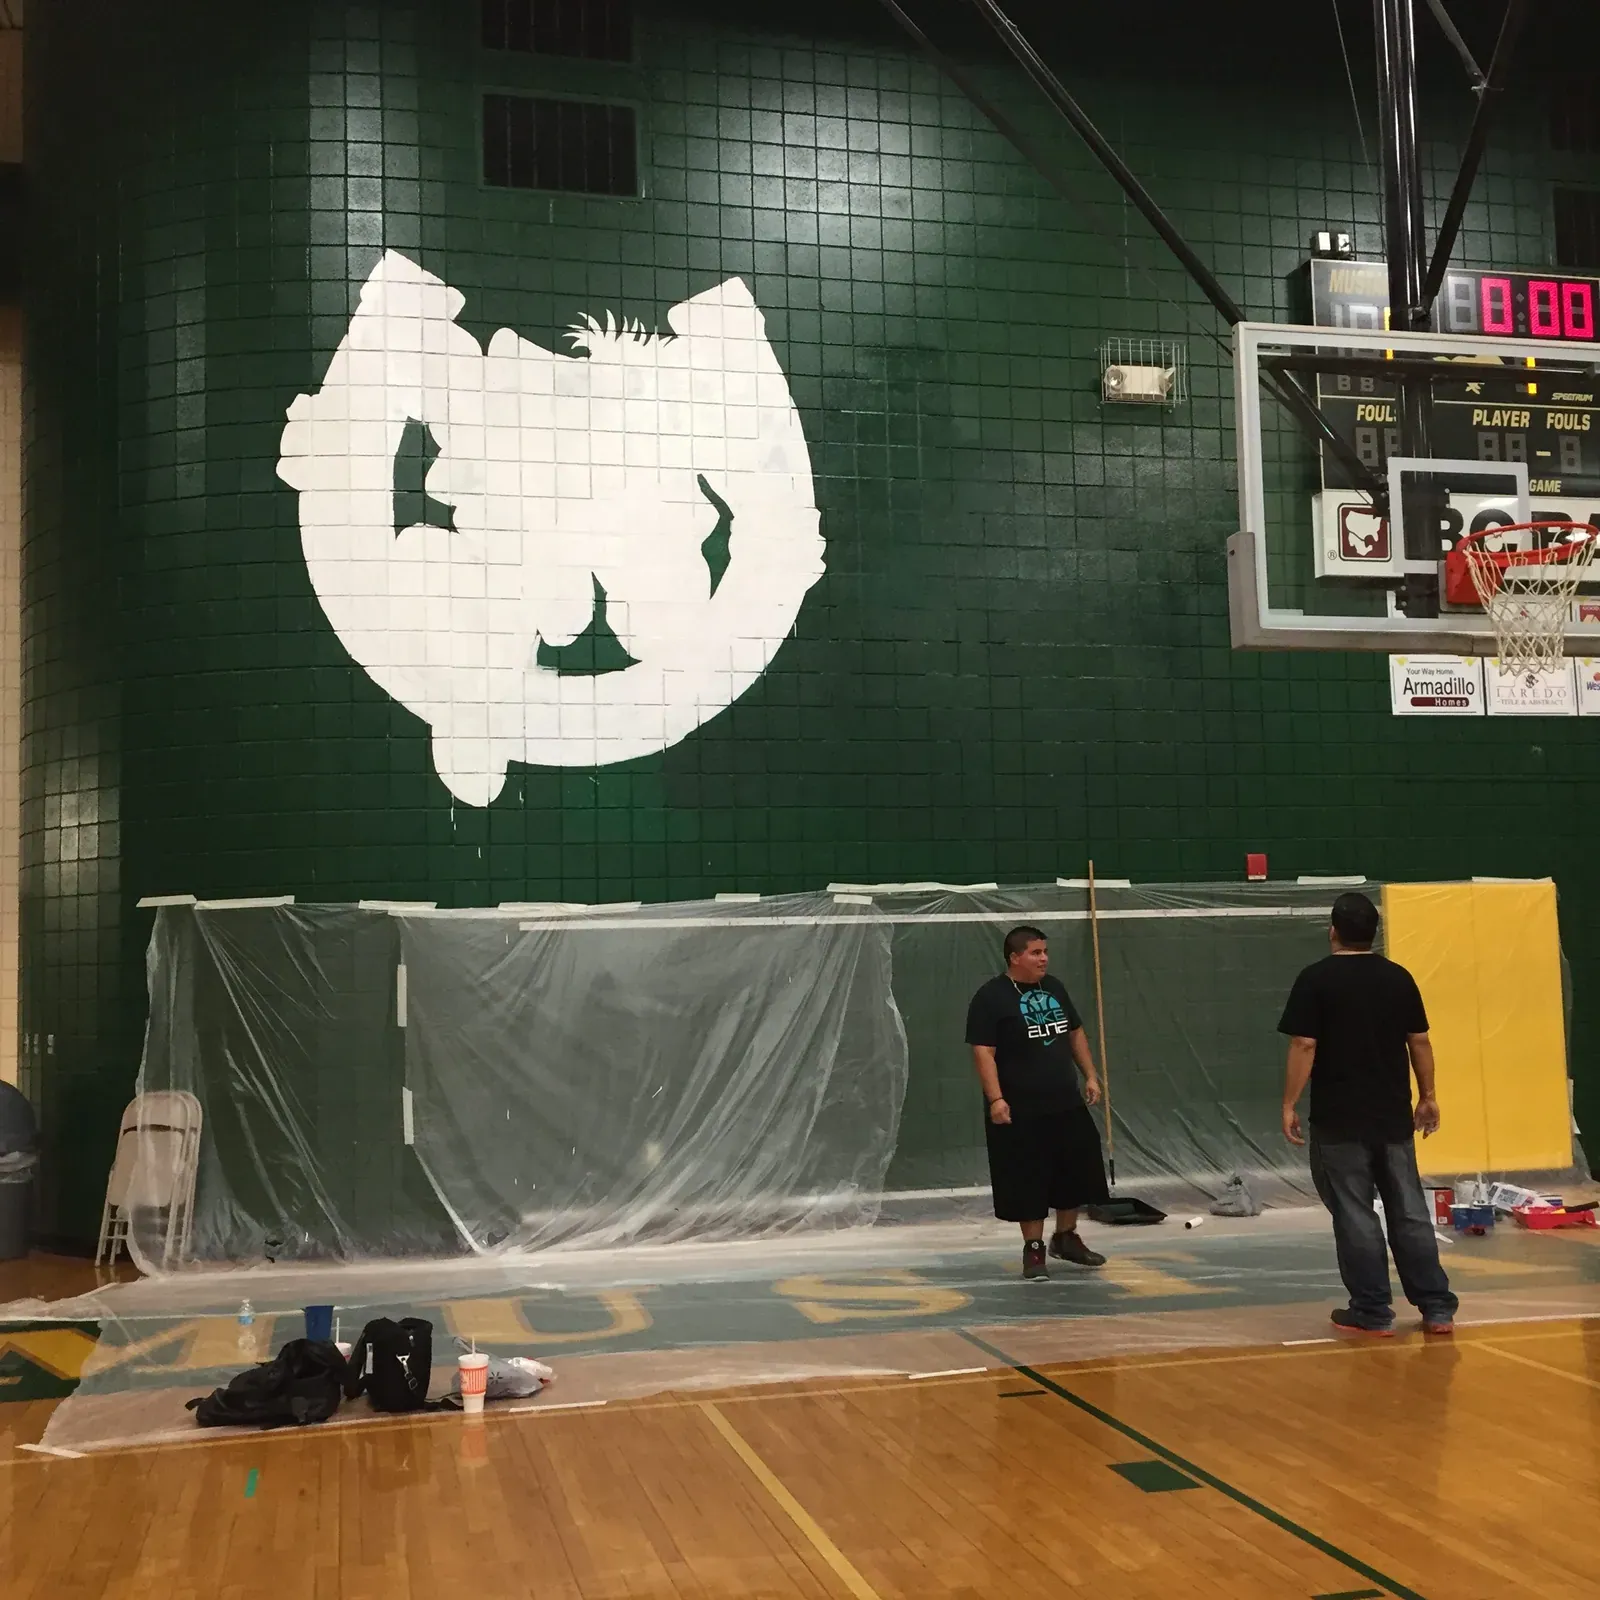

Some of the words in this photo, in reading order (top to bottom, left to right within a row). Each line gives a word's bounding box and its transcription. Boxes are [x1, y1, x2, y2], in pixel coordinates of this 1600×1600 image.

[1551, 392, 1593, 402] SPECTRUM
[1472, 408, 1531, 428] PLAYER
[1546, 412, 1592, 431] FOULS
[1529, 479, 1562, 493] GAME
[1406, 667, 1420, 675] Your
[1421, 667, 1435, 676] Way
[1403, 677, 1475, 695] Armadillo
[1496, 688, 1567, 698] LAREDO
[1435, 697, 1467, 706] Homes
[1024, 1009, 1067, 1026] NIKE
[1027, 1020, 1068, 1038] ELITE
